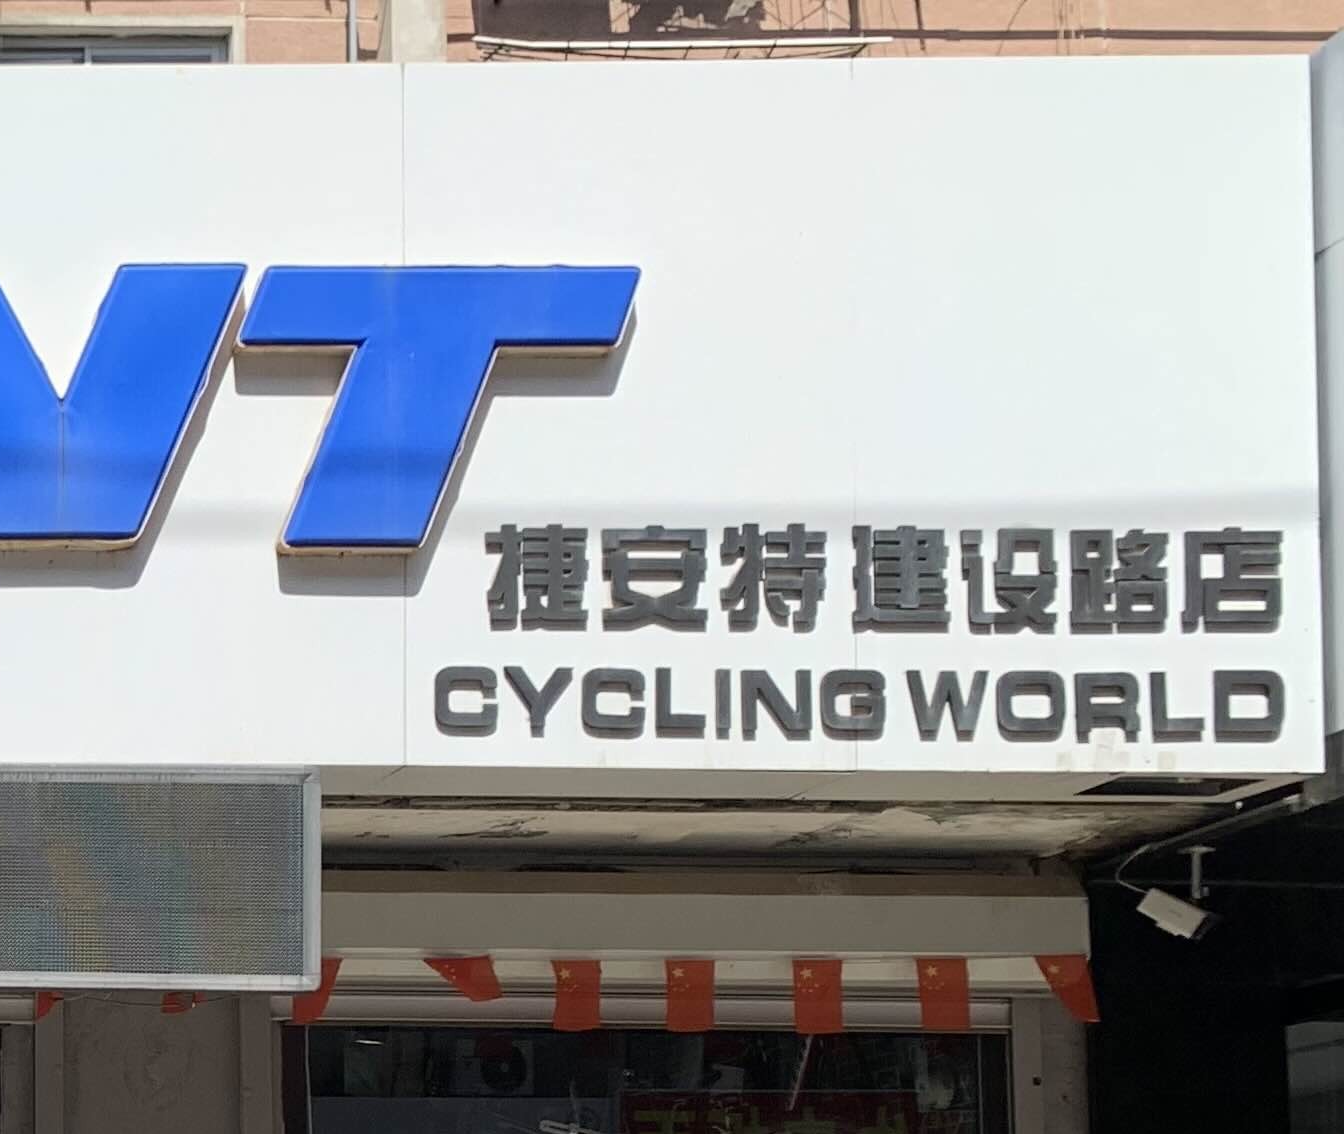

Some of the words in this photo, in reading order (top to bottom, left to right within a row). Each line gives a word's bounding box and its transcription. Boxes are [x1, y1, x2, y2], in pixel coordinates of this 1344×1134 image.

[485, 523, 1284, 634] 捷安特建设路店
[433, 664, 887, 741] CYCLING
[906, 668, 1287, 743] WORLD
